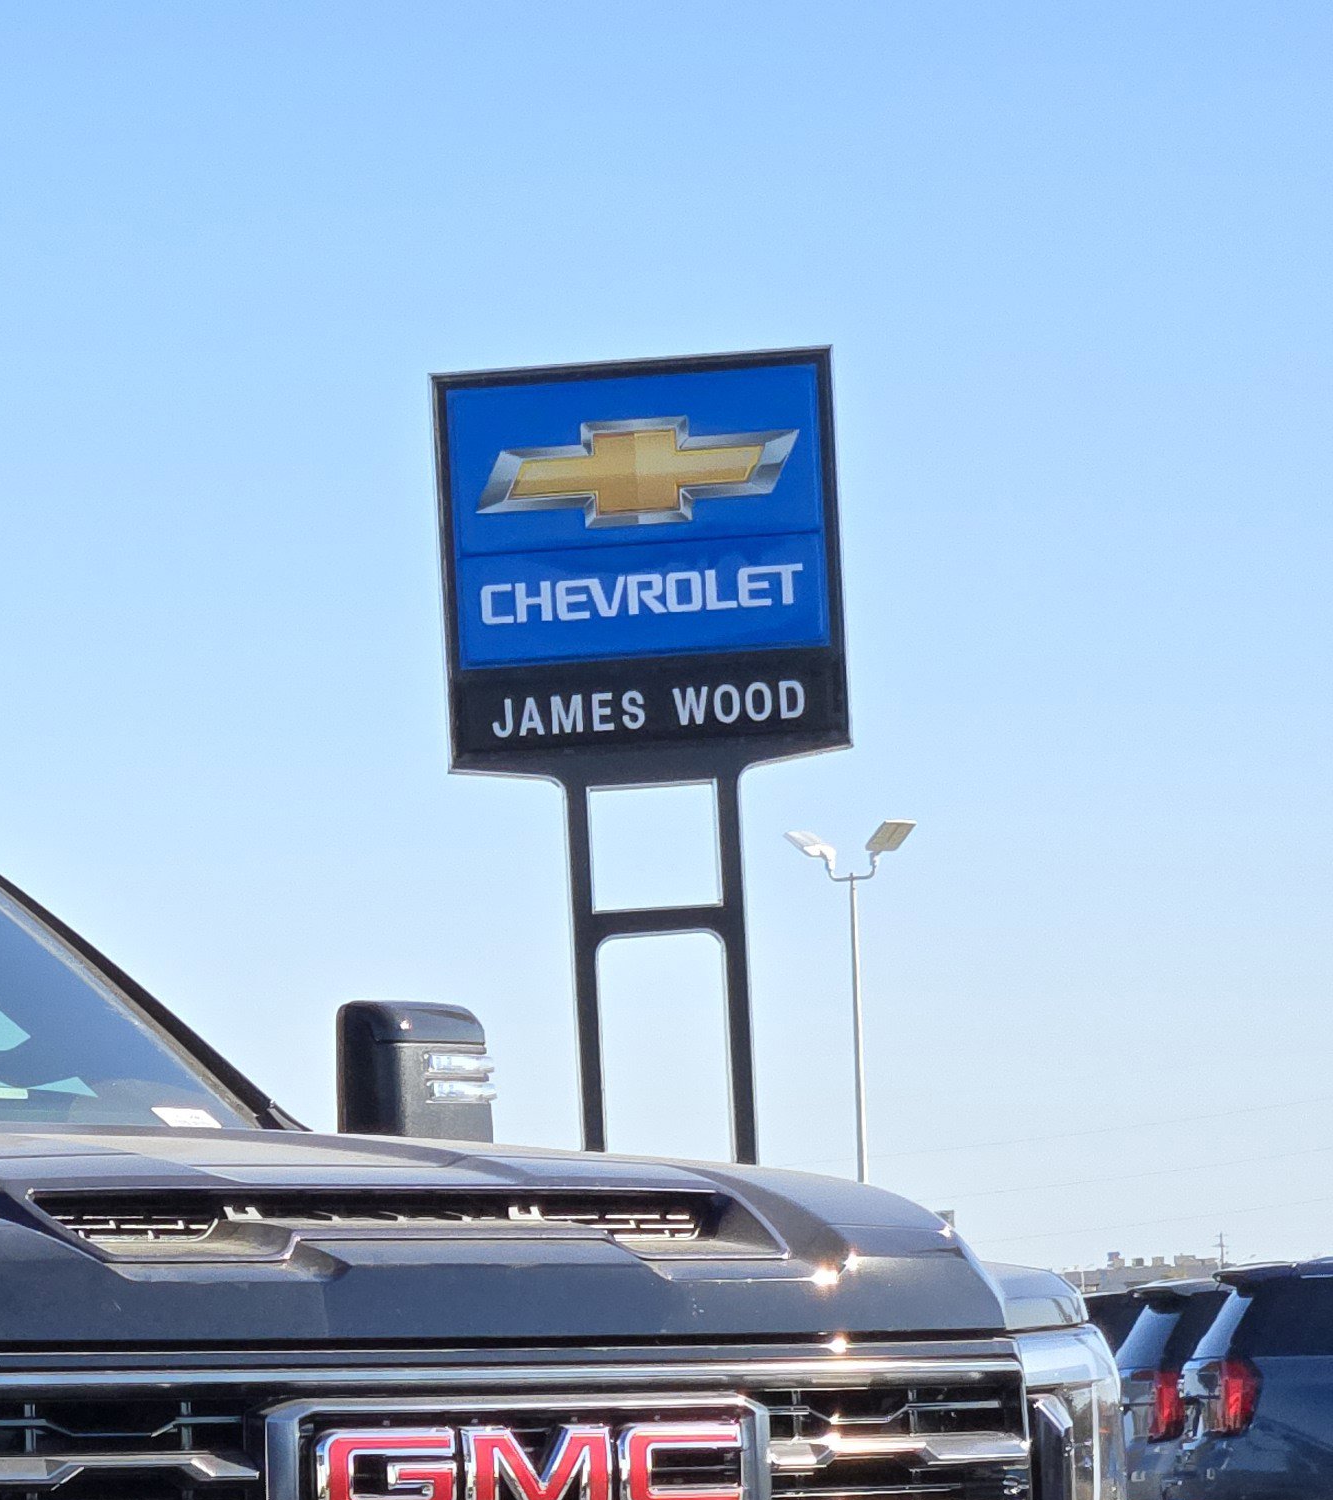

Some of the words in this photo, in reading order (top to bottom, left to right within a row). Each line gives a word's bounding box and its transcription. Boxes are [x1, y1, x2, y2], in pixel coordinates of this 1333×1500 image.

[480, 563, 803, 626] CHEVROLET
[491, 690, 646, 738] JAMES
[672, 680, 805, 726] WOOD
